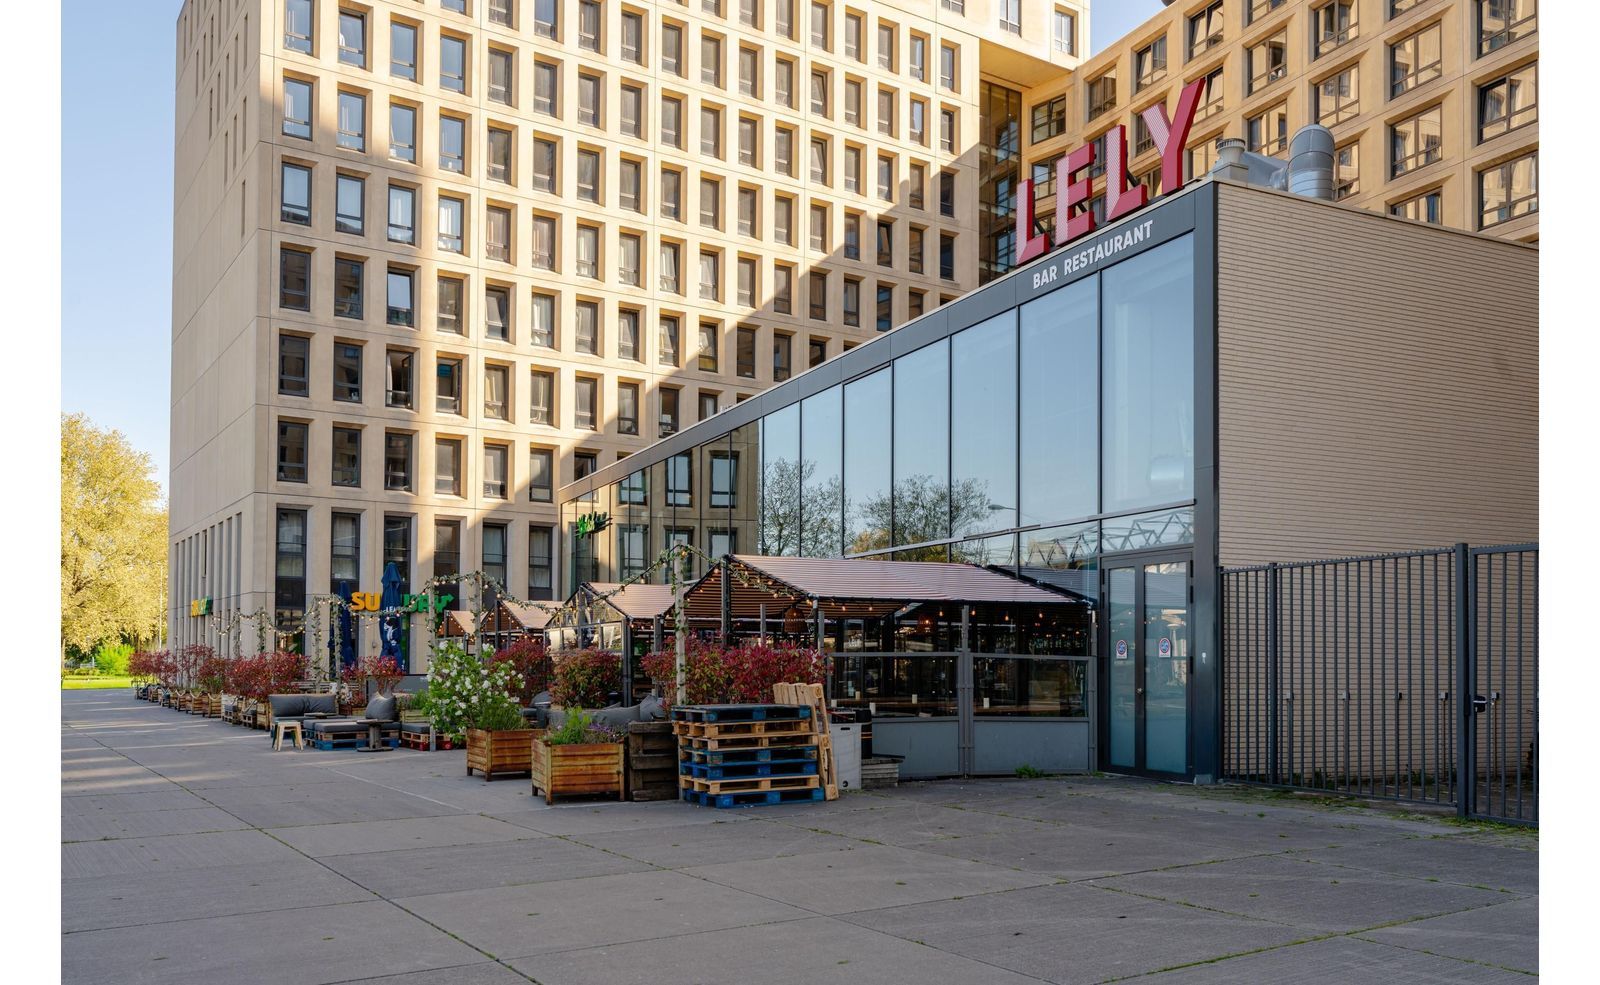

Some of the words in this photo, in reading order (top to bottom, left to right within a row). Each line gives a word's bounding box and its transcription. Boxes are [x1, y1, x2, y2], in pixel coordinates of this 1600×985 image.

[1015, 77, 1206, 266] LELY
[1032, 265, 1058, 289] BAR
[1063, 220, 1153, 276] RESTAURANT
[351, 591, 454, 613] SUWAY
